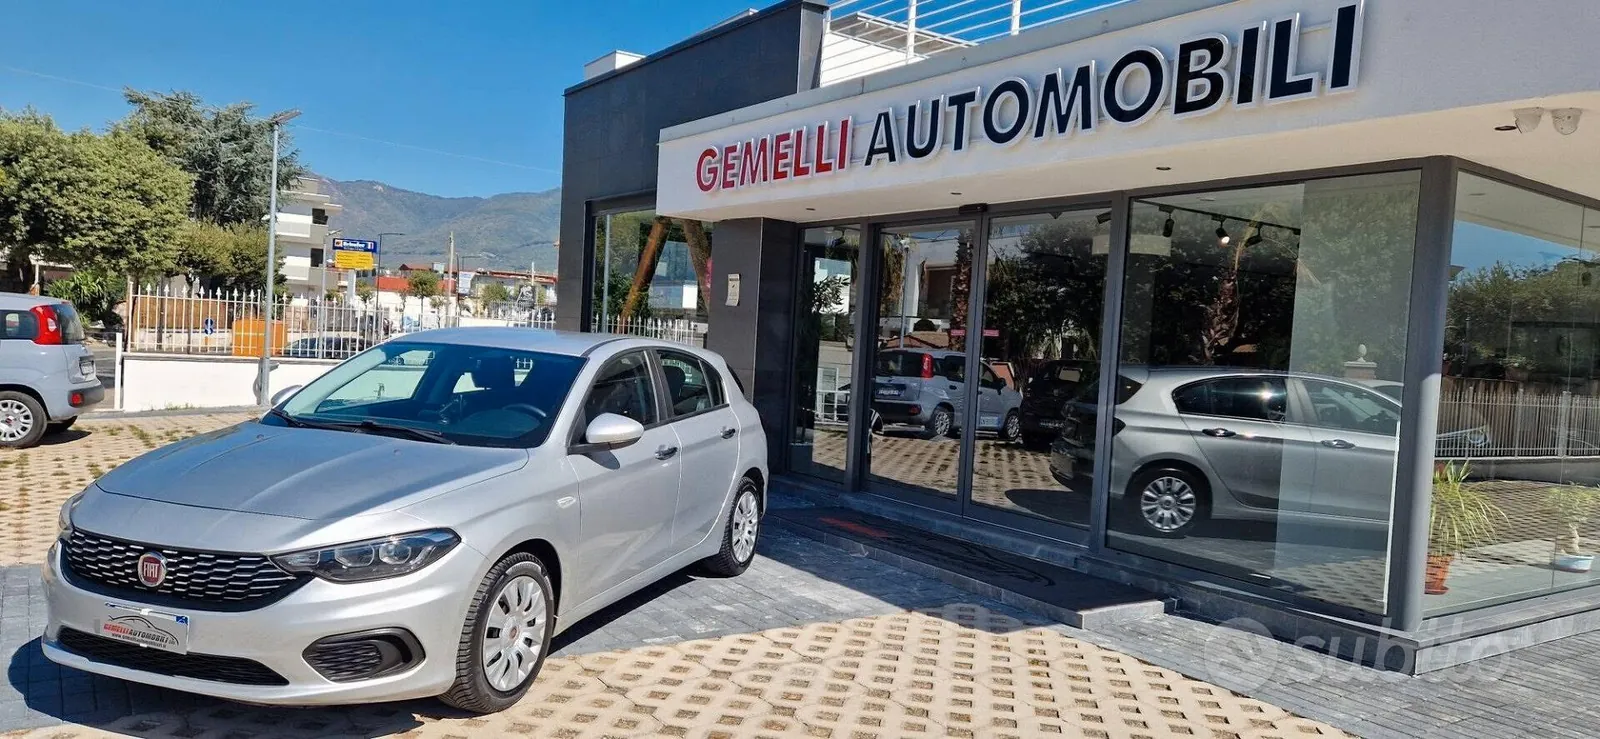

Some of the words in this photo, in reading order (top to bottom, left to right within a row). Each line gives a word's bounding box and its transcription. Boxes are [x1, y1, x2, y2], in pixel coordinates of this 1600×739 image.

[695, 117, 852, 193] GEMELLI
[865, 4, 1362, 166] AUTOMOBILI
[143, 562, 159, 577] FIAT
[129, 629, 169, 644] AUTOMOBILI
